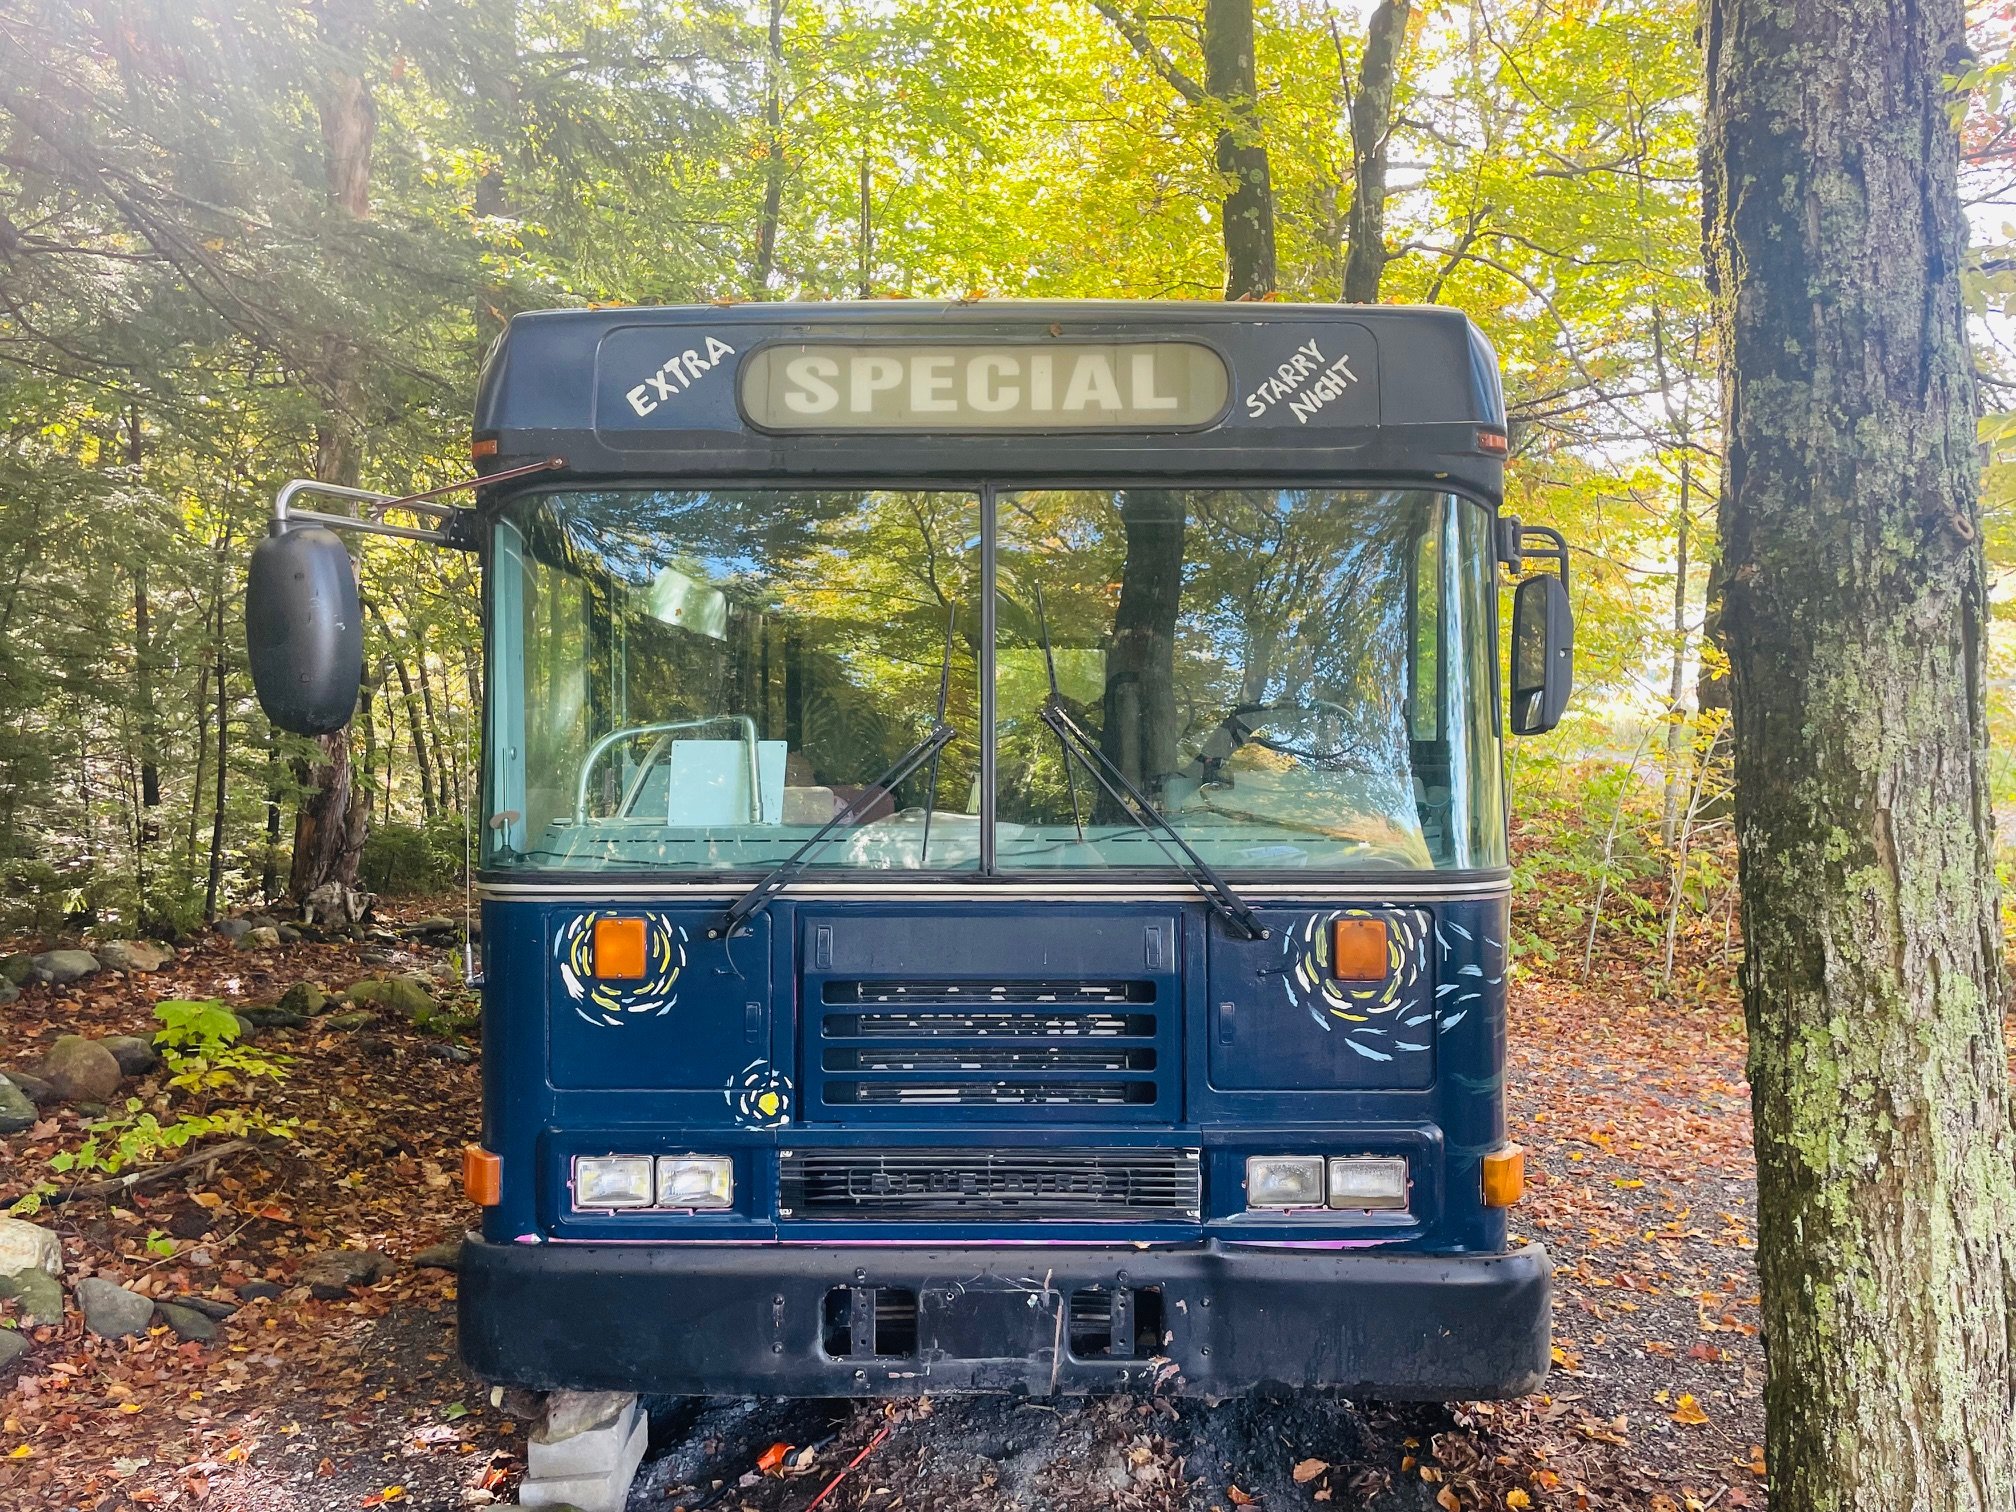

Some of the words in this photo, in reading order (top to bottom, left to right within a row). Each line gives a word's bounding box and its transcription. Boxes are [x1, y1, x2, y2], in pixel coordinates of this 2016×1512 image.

[625, 336, 736, 417] EXTRA
[783, 354, 1178, 414] SPECIAL
[1246, 338, 1325, 417] STARRY
[1288, 354, 1358, 424] NIGHT
[871, 1172, 978, 1193] BLUE
[1004, 1173, 1107, 1193] BIRD
